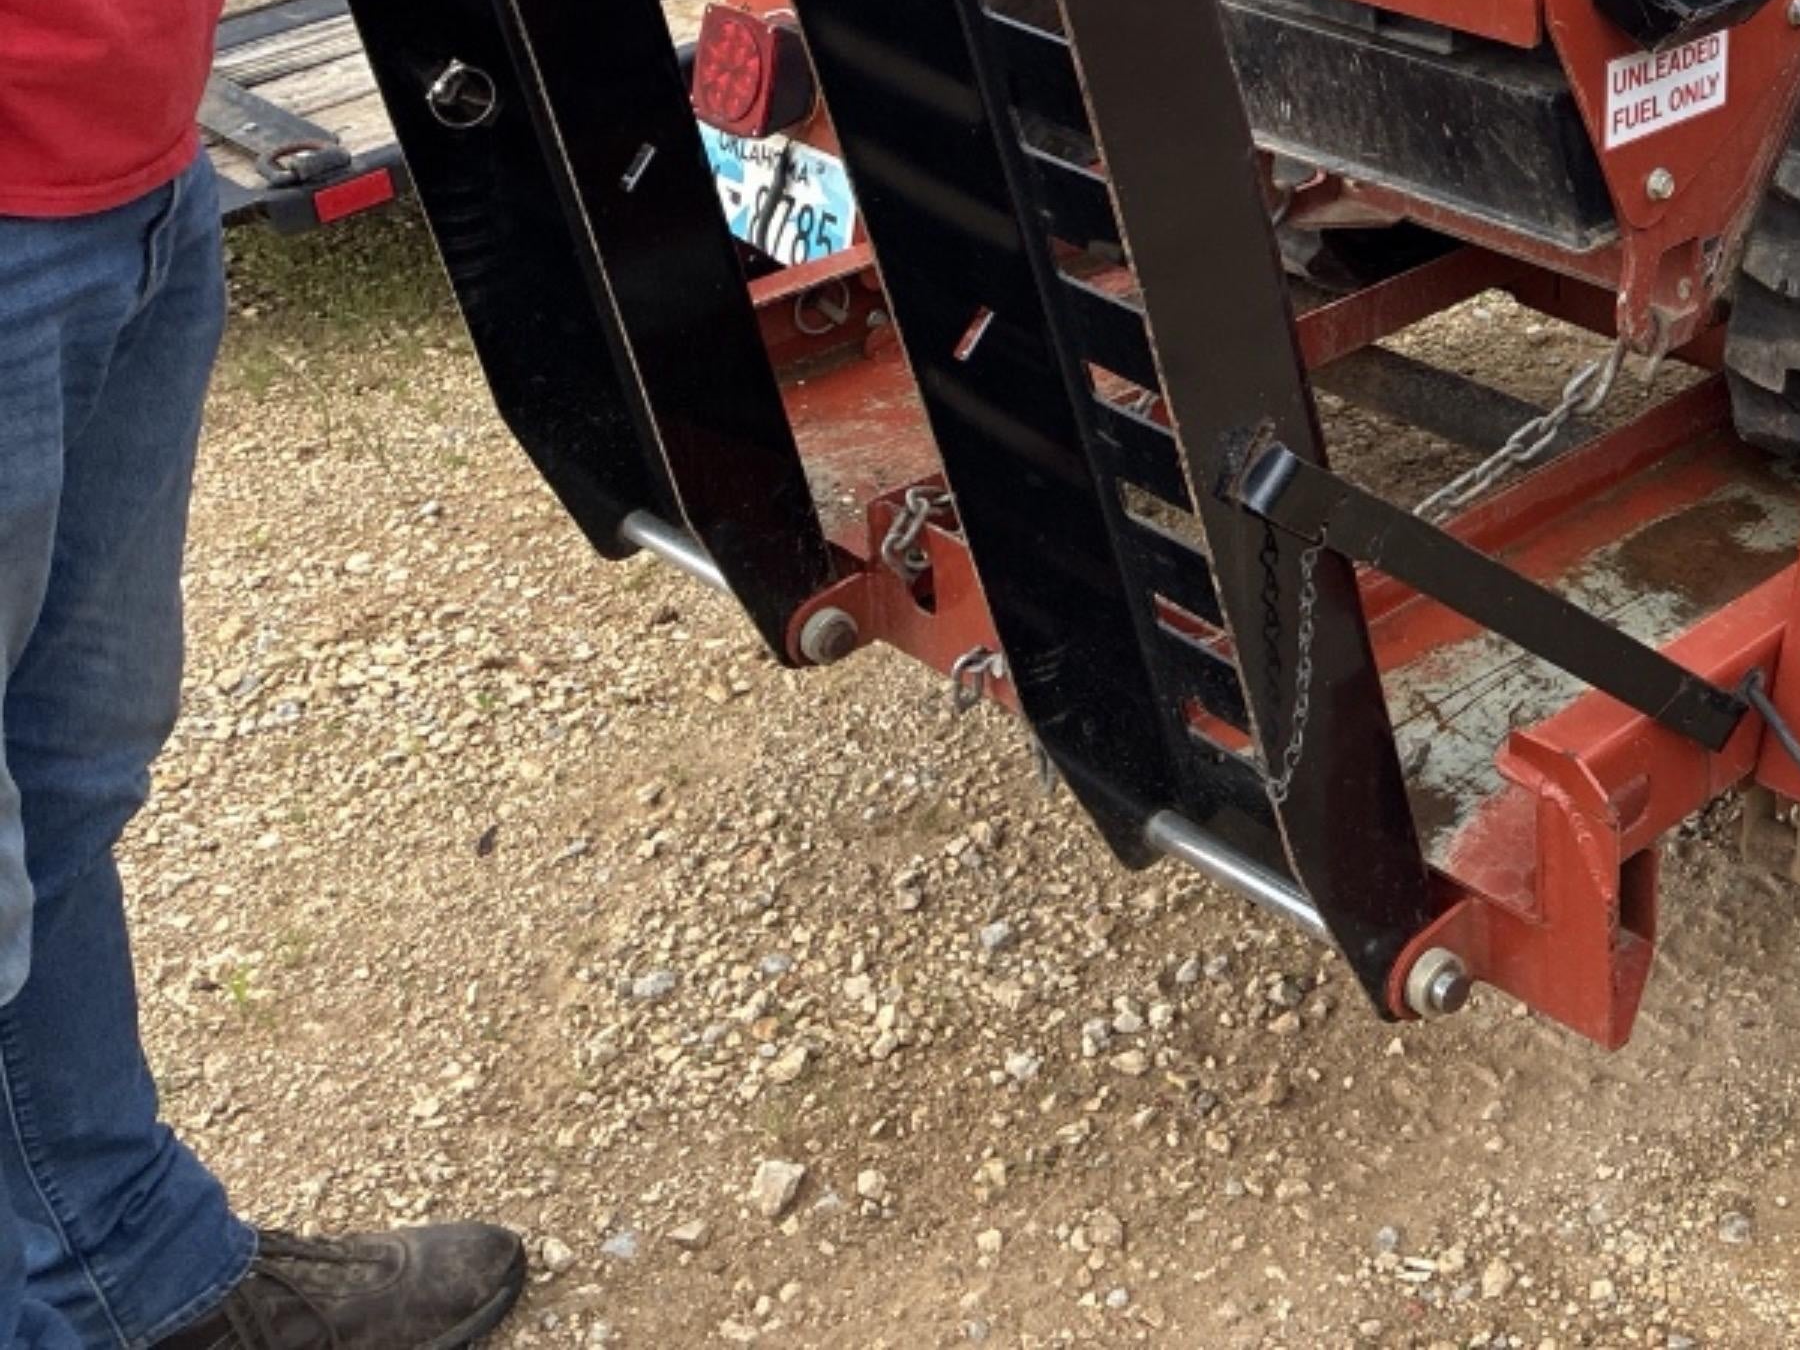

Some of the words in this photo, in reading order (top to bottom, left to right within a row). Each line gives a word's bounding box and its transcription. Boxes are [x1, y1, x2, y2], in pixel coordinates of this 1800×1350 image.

[1612, 36, 1721, 96] UNLEADED
[1612, 95, 1663, 136] FUEL
[1668, 71, 1721, 113] ONLY
